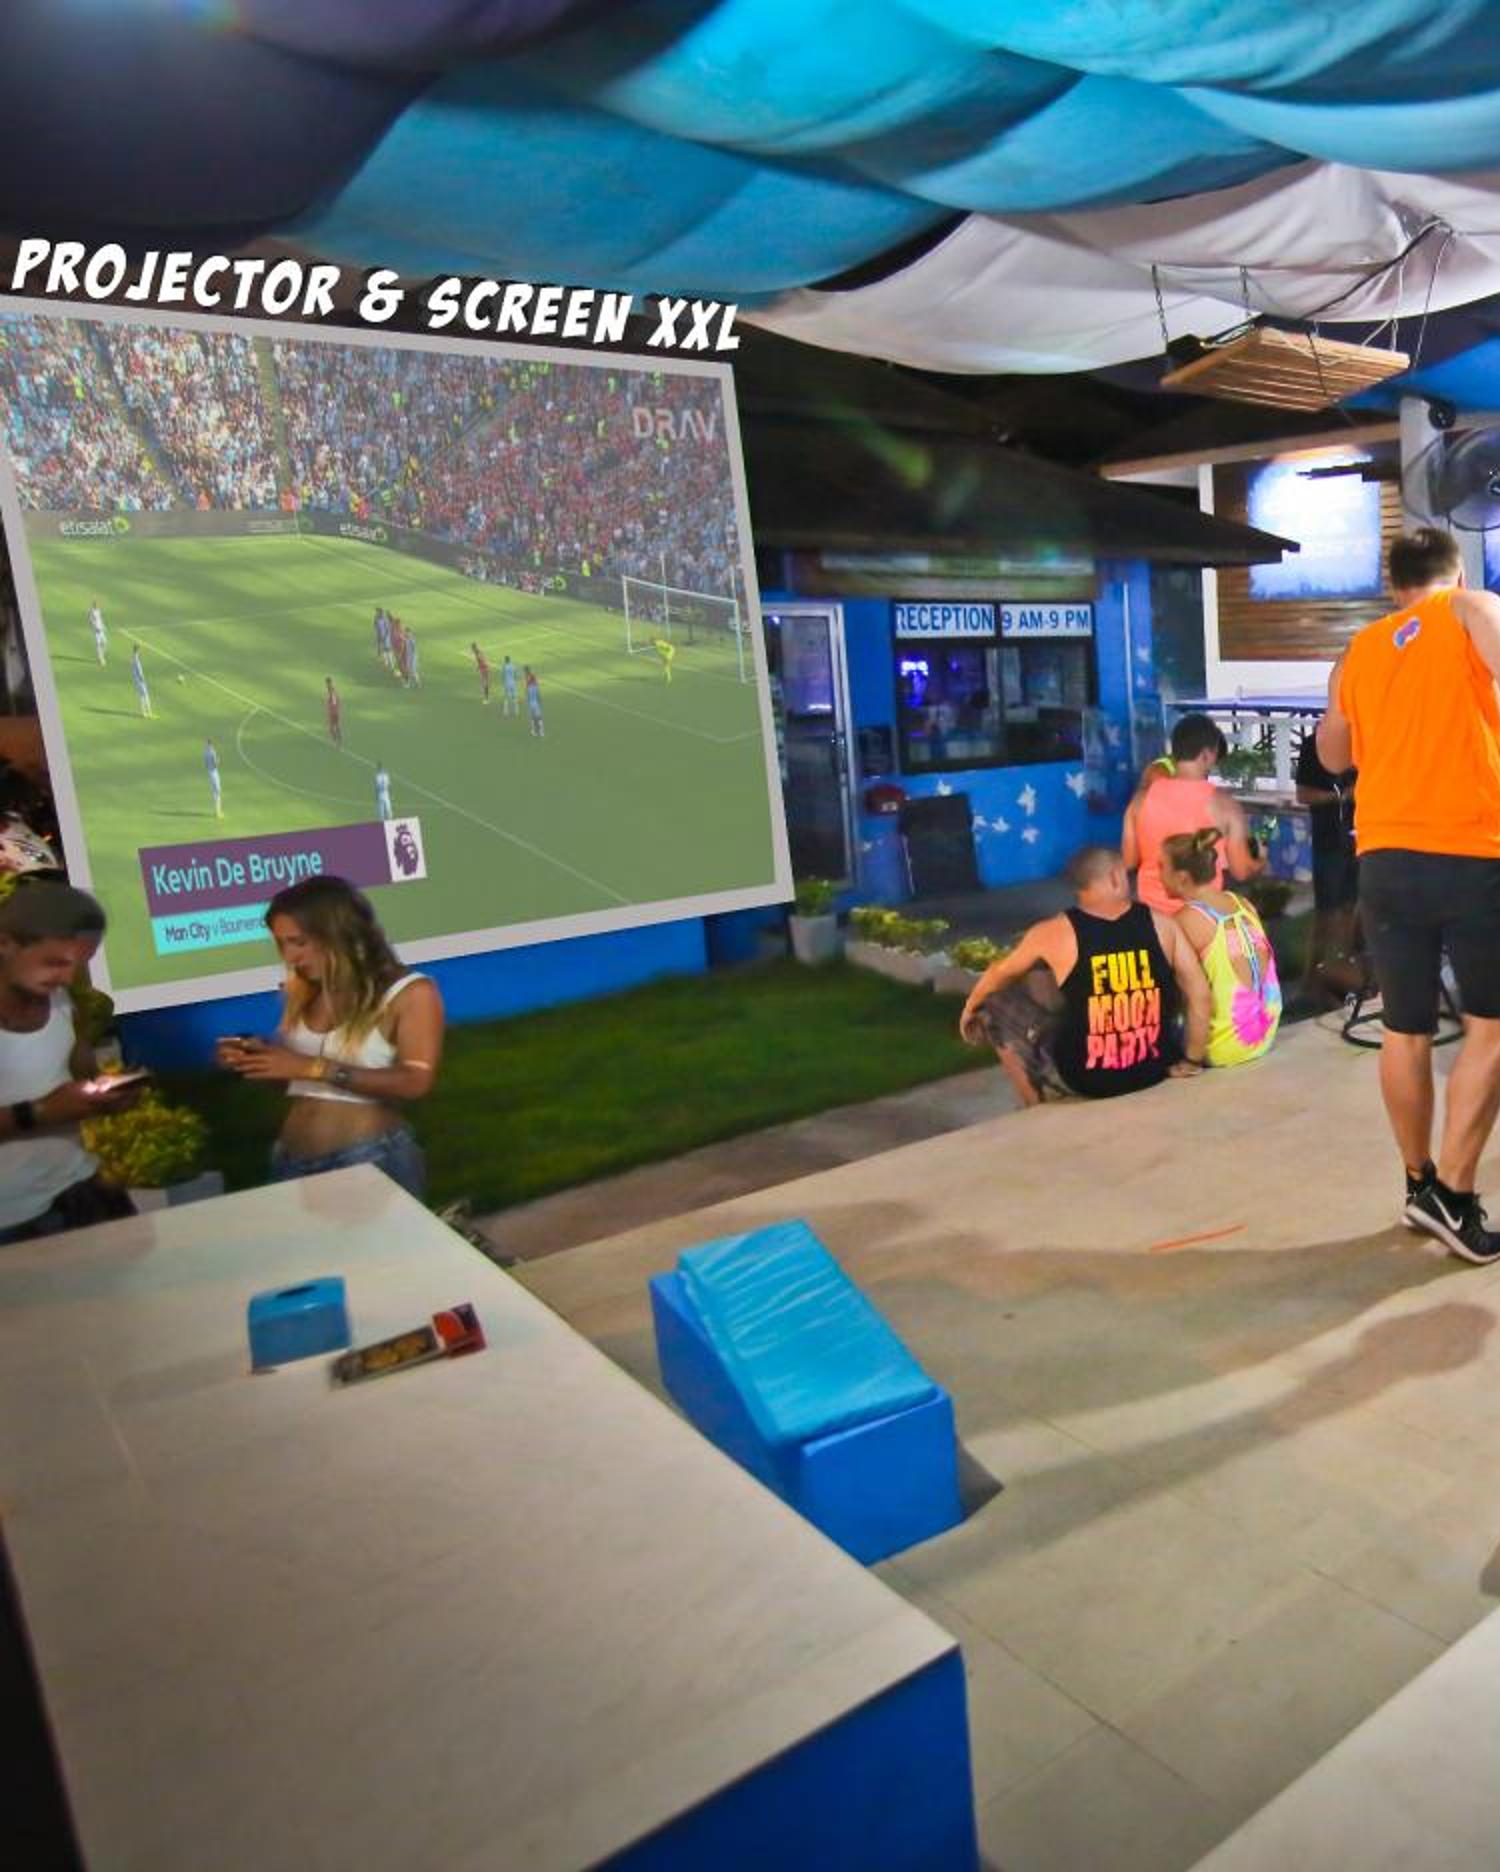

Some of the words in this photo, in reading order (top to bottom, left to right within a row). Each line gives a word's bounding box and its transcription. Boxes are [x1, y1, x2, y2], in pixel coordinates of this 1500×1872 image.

[896, 606, 993, 630] RECEPTION
[1002, 611, 1012, 631] 9
[1066, 610, 1089, 628] PM
[152, 858, 214, 896] Kevin
[215, 857, 246, 888] De
[249, 851, 322, 887] Bruyne
[165, 925, 189, 942] Man
[189, 922, 211, 941] City
[1091, 949, 1155, 995] FULL
[1088, 988, 1161, 1034] MOON
[1086, 1024, 1161, 1070] PARTY
